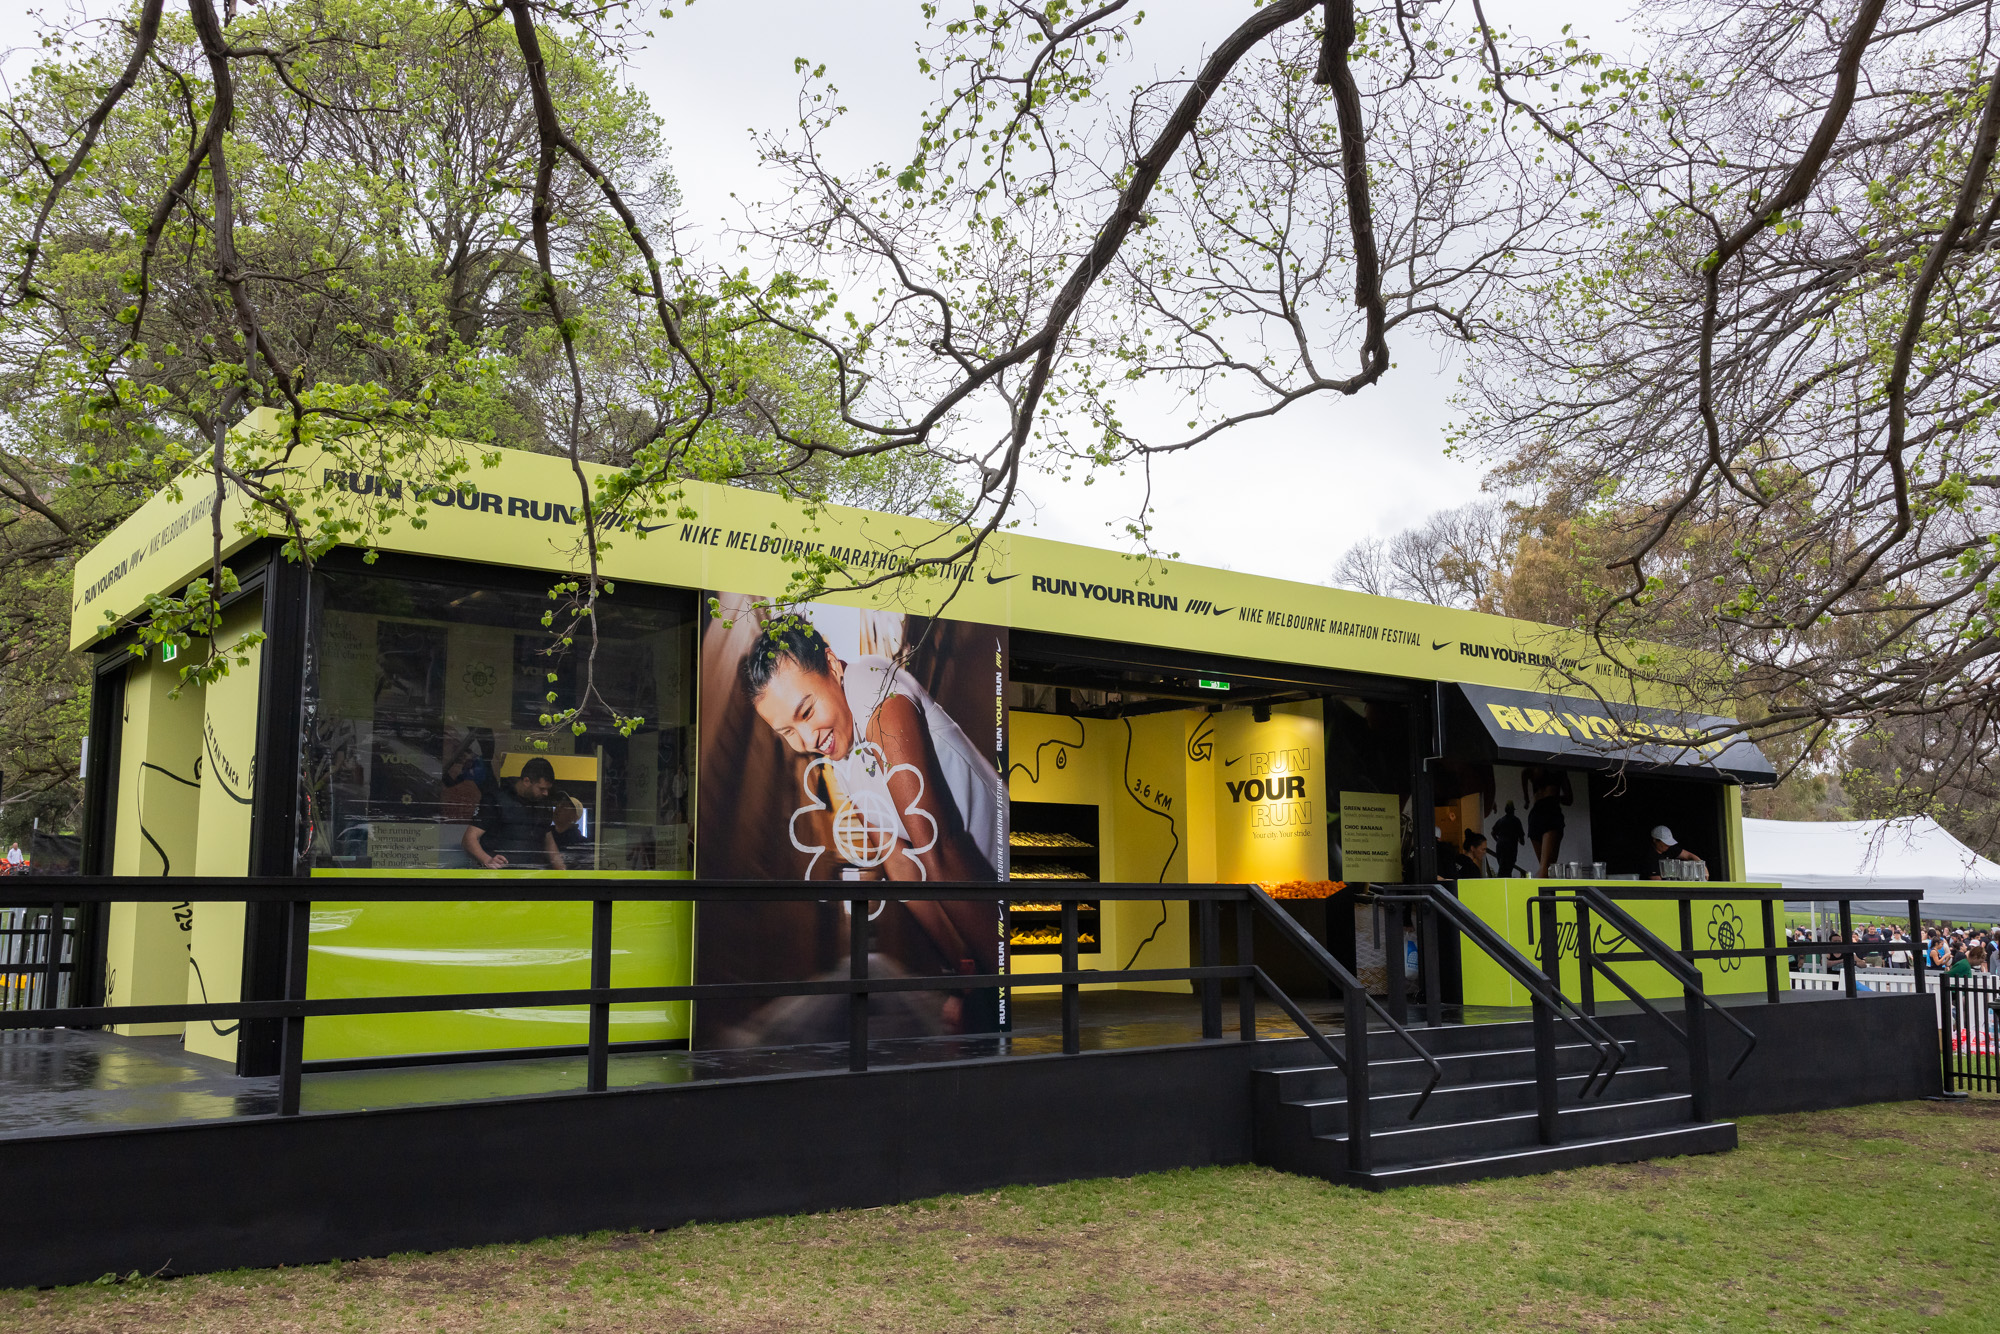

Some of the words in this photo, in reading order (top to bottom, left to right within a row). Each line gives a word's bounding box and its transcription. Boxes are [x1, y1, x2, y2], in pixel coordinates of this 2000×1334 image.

[323, 468, 402, 500] RUN
[507, 496, 577, 526] RUN
[149, 532, 161, 557] NIKE
[160, 510, 191, 548] MELBOURNE
[190, 489, 216, 527] MARATHO
[680, 523, 722, 547] NIKE
[725, 530, 825, 559] MELBOURNE
[914, 557, 975, 583] TIVAL
[84, 582, 97, 606] RUN
[97, 571, 115, 596] YOUR
[113, 557, 128, 583] RUN
[1032, 575, 1077, 597] RUN
[1079, 583, 1135, 606] YOUR
[1137, 590, 1178, 612] RUN
[1238, 606, 1263, 624] NIKE
[1266, 610, 1326, 633] MELBOURNE
[1329, 619, 1379, 641] MARATHON
[1381, 628, 1421, 647] FESTIVAL
[1459, 642, 1489, 659] RUN
[1490, 646, 1527, 664] YOUR
[1528, 653, 1555, 667] RUN
[995, 671, 1003, 696] RUN
[1595, 663, 1612, 677] NIKE
[995, 696, 1003, 727] YOUR
[1486, 703, 1571, 737] RUN
[206, 712, 214, 741] THE
[212, 736, 222, 763] TAN
[221, 754, 240, 788] TRACK
[995, 727, 1003, 752] RUN
[1249, 747, 1311, 776] RUN
[1134, 778, 1151, 798] 3.6
[1154, 789, 1173, 811] KM
[1225, 775, 1306, 804] YOUR
[996, 808, 1004, 847] MARATHON
[1251, 801, 1312, 828] RUN
[371, 835, 417, 844] ommunity
[389, 827, 421, 838] running
[1252, 831, 1266, 840] Your
[1279, 830, 1293, 838] Your
[1293, 828, 1313, 837] stride.
[371, 843, 405, 853] provides
[380, 850, 420, 862] belonging
